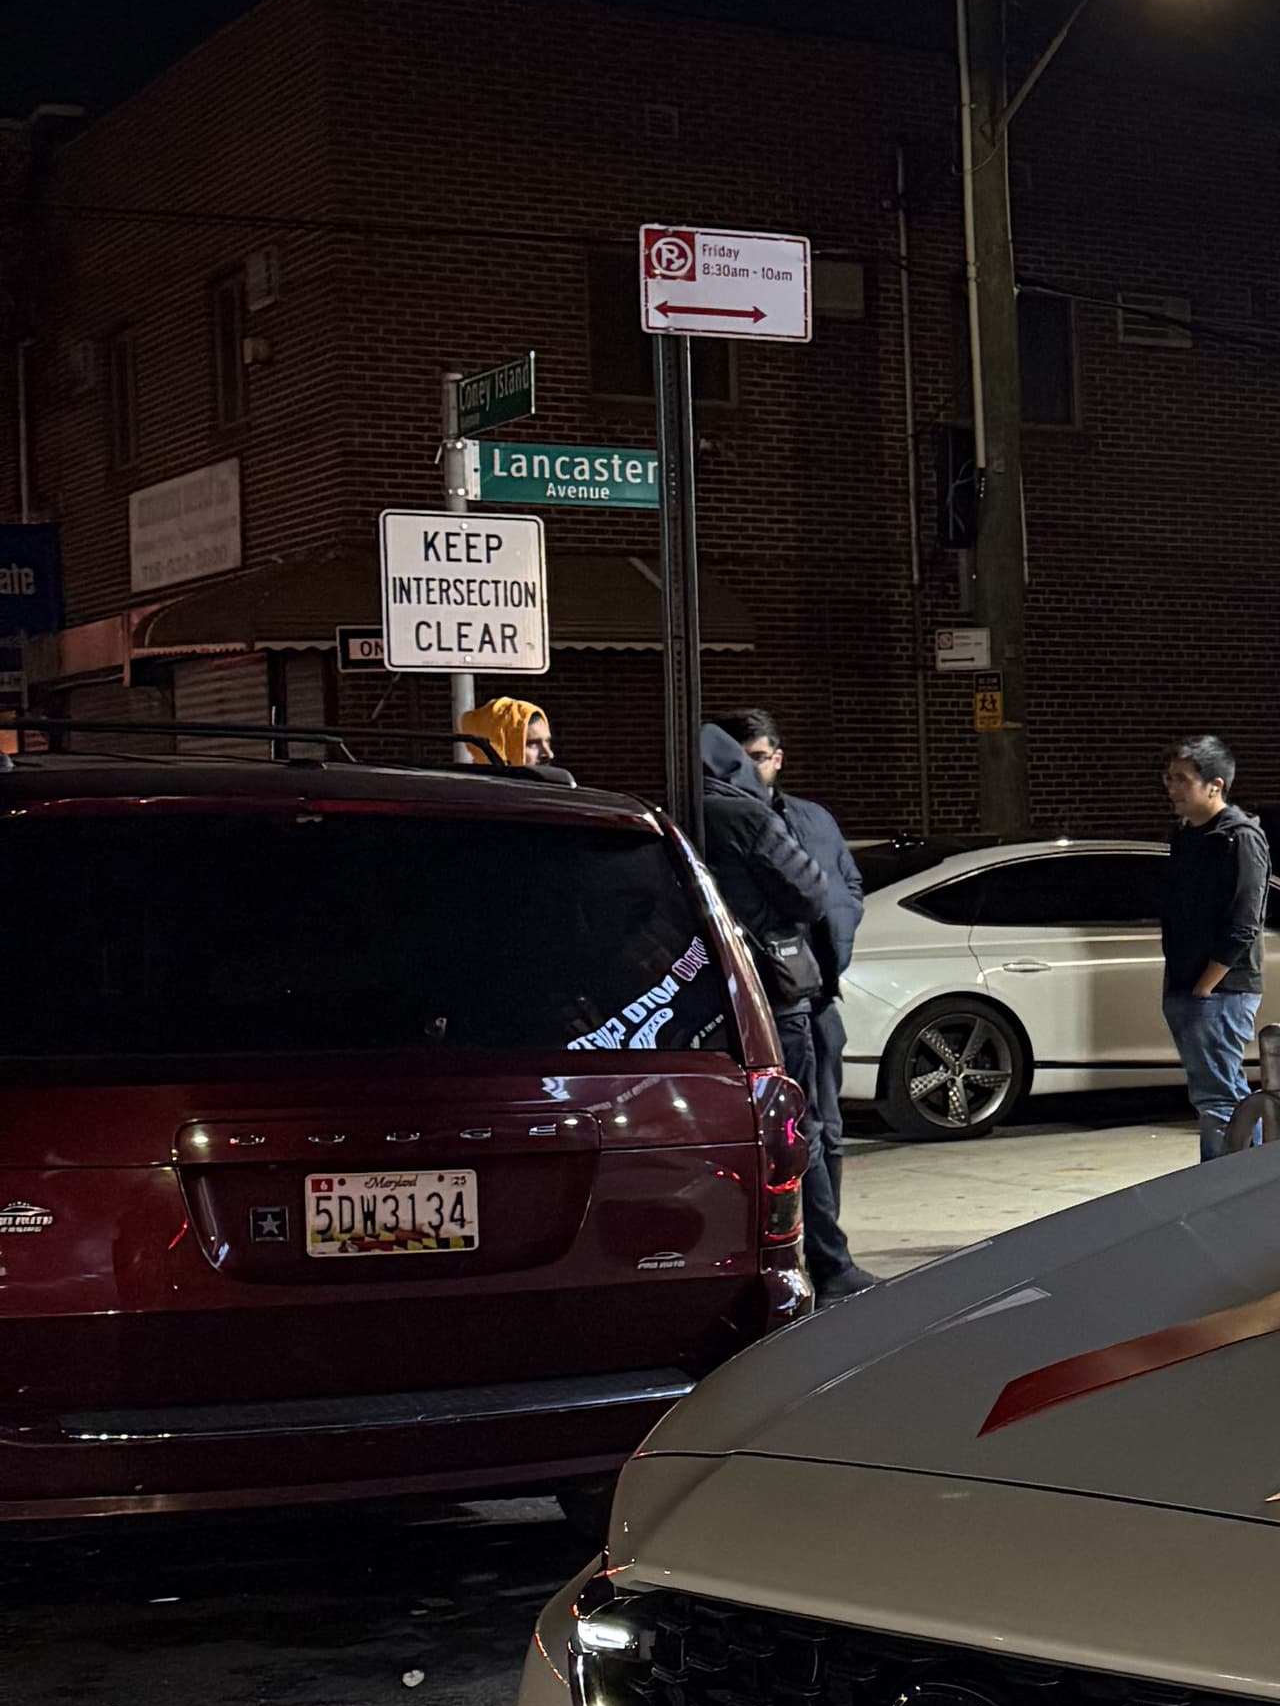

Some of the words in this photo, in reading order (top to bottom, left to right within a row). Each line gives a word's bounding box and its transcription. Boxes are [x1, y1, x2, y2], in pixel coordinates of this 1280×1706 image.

[702, 243, 740, 261] Friday
[702, 262, 749, 279] 8:30am
[761, 265, 793, 281] 10am
[459, 373, 491, 413] Coney
[493, 360, 530, 399] Island
[492, 447, 660, 485] Lancaster
[545, 482, 611, 501] Avenue
[423, 531, 503, 564] KEEP
[391, 576, 537, 608] INTERSECTION
[414, 620, 519, 654] CLEAR
[364, 1174, 420, 1192] Maryland
[314, 1191, 467, 1238] 5DW3134
